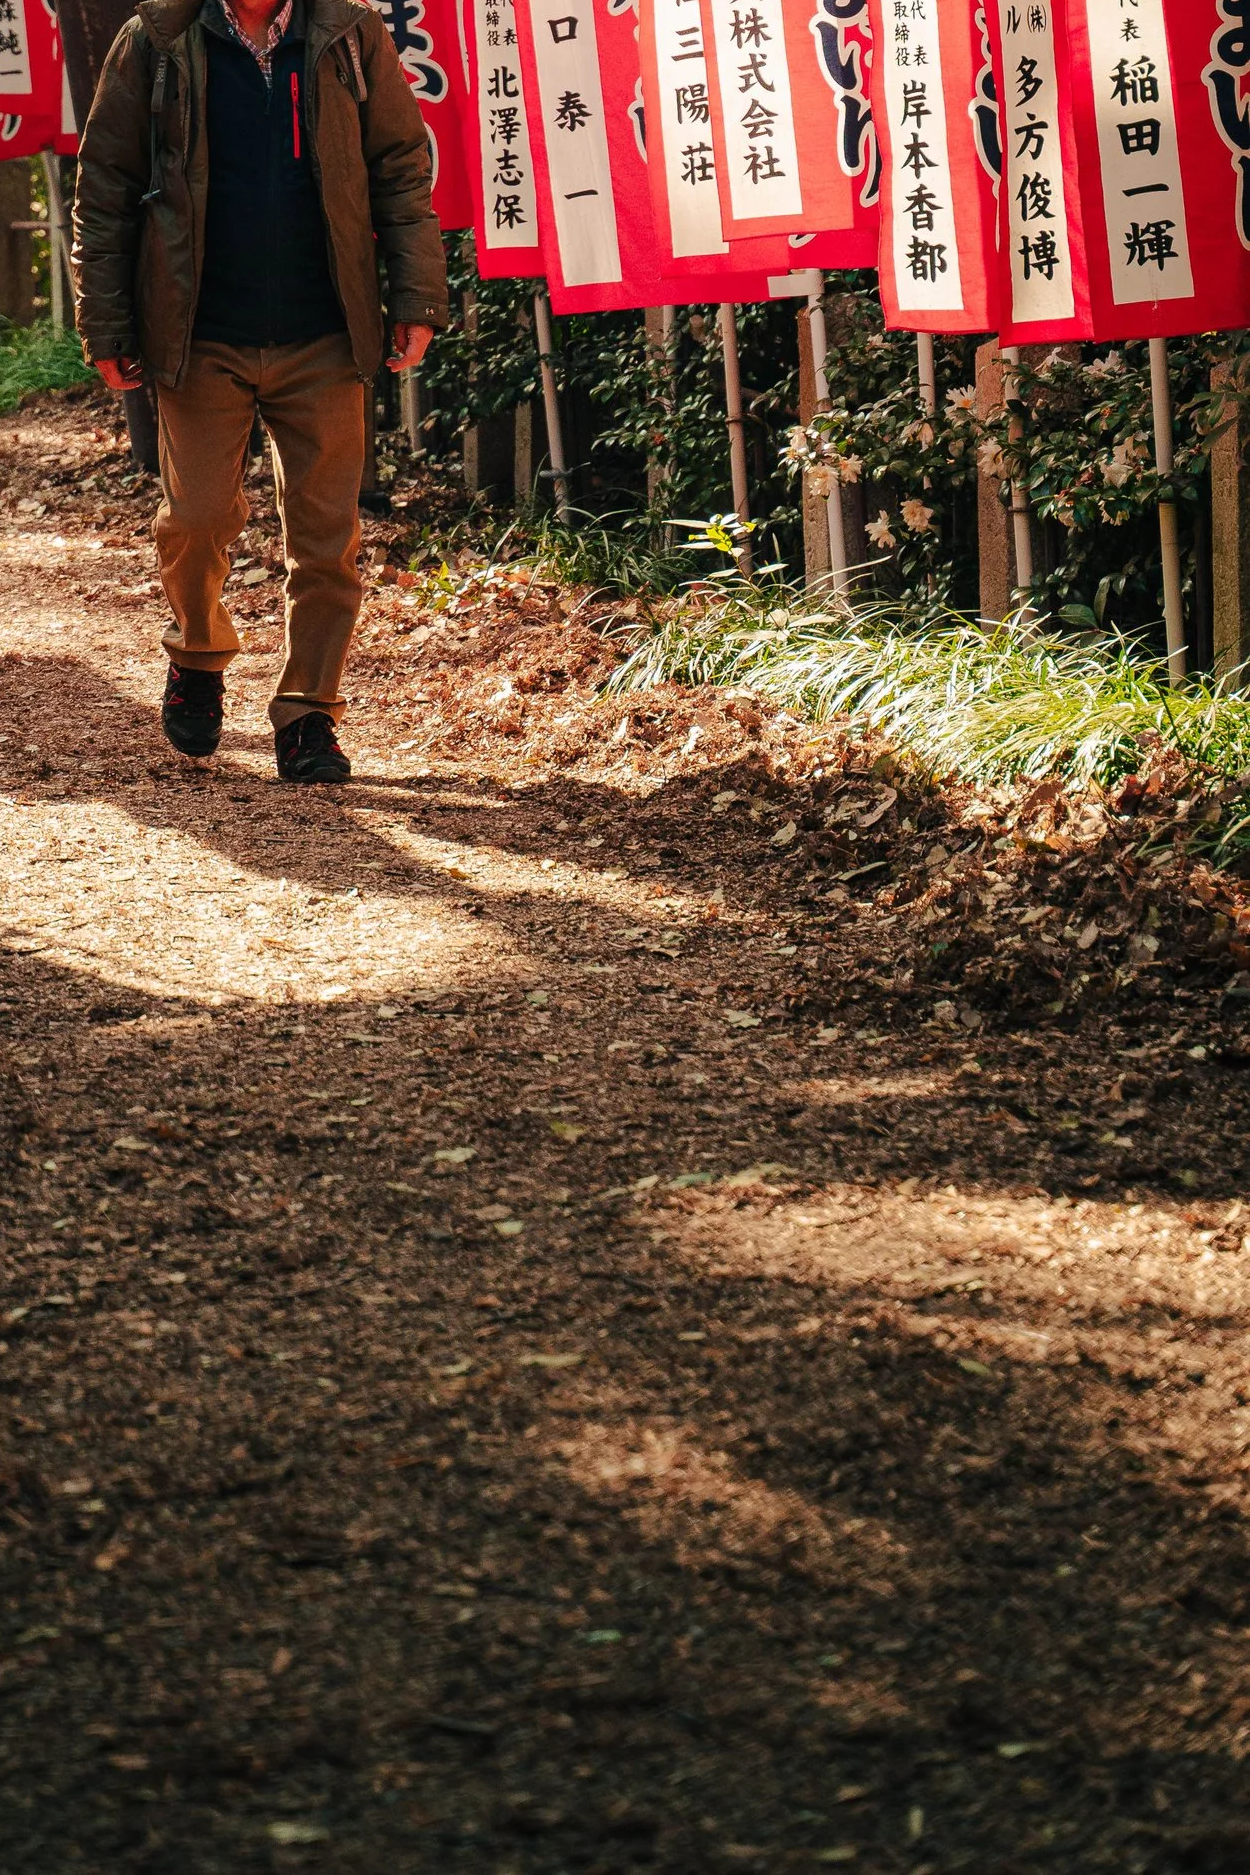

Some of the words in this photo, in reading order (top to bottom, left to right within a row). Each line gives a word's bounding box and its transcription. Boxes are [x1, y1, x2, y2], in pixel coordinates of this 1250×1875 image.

[487, 65, 528, 230] 北澤志保
[900, 79, 947, 283] 岸本香都
[1014, 55, 1060, 281] 多方俊博
[1109, 55, 1179, 272] 稲田一輝
